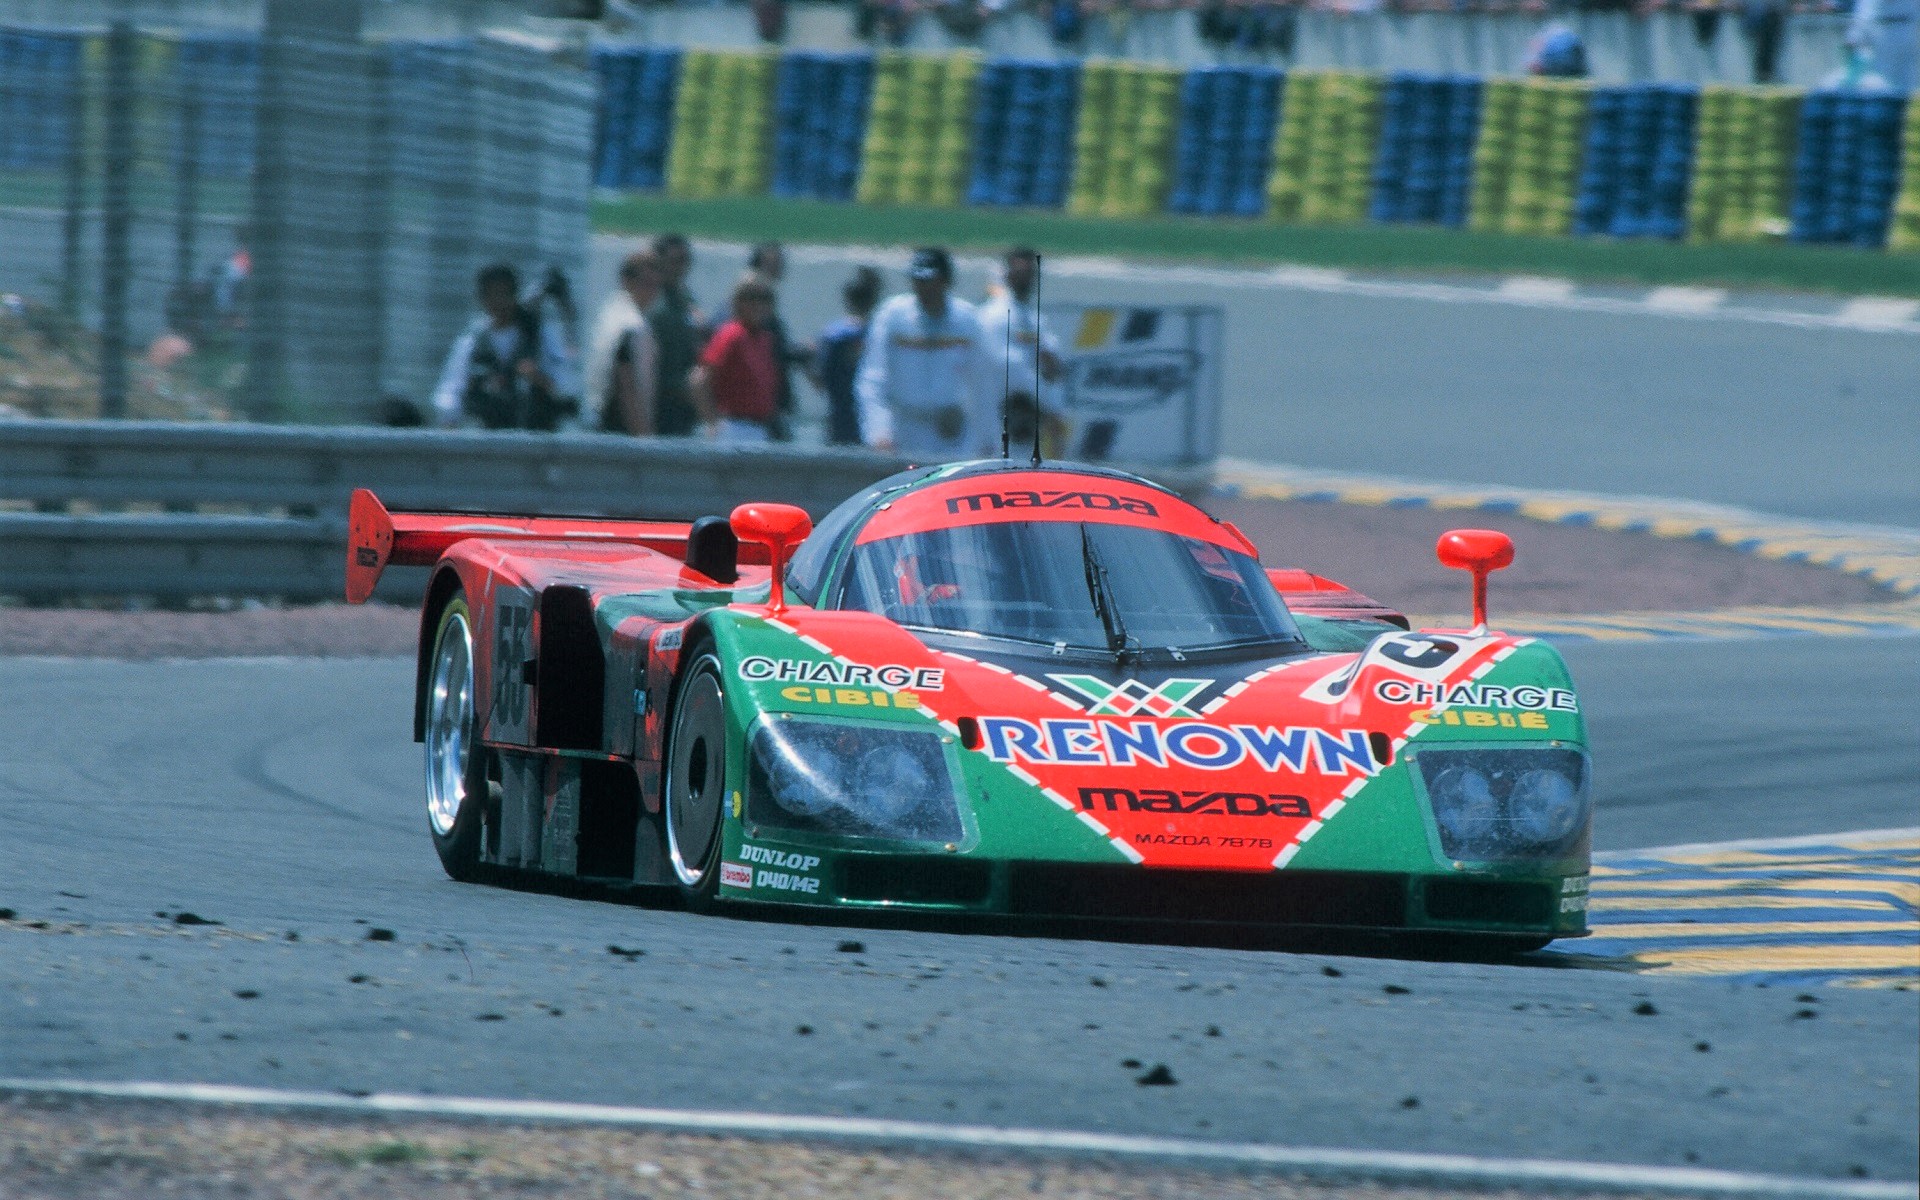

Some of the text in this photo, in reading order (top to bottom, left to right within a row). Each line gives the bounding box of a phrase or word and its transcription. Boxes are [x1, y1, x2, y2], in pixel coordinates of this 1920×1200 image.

[946, 491, 1160, 518] mazda
[739, 656, 944, 691] CHARGE
[1375, 680, 1578, 711] CHARGE
[977, 716, 1380, 776] RENOWN
[1077, 787, 1312, 818] mazda
[1135, 833, 1211, 848] MAZDA
[740, 844, 820, 871] DUNLOP
